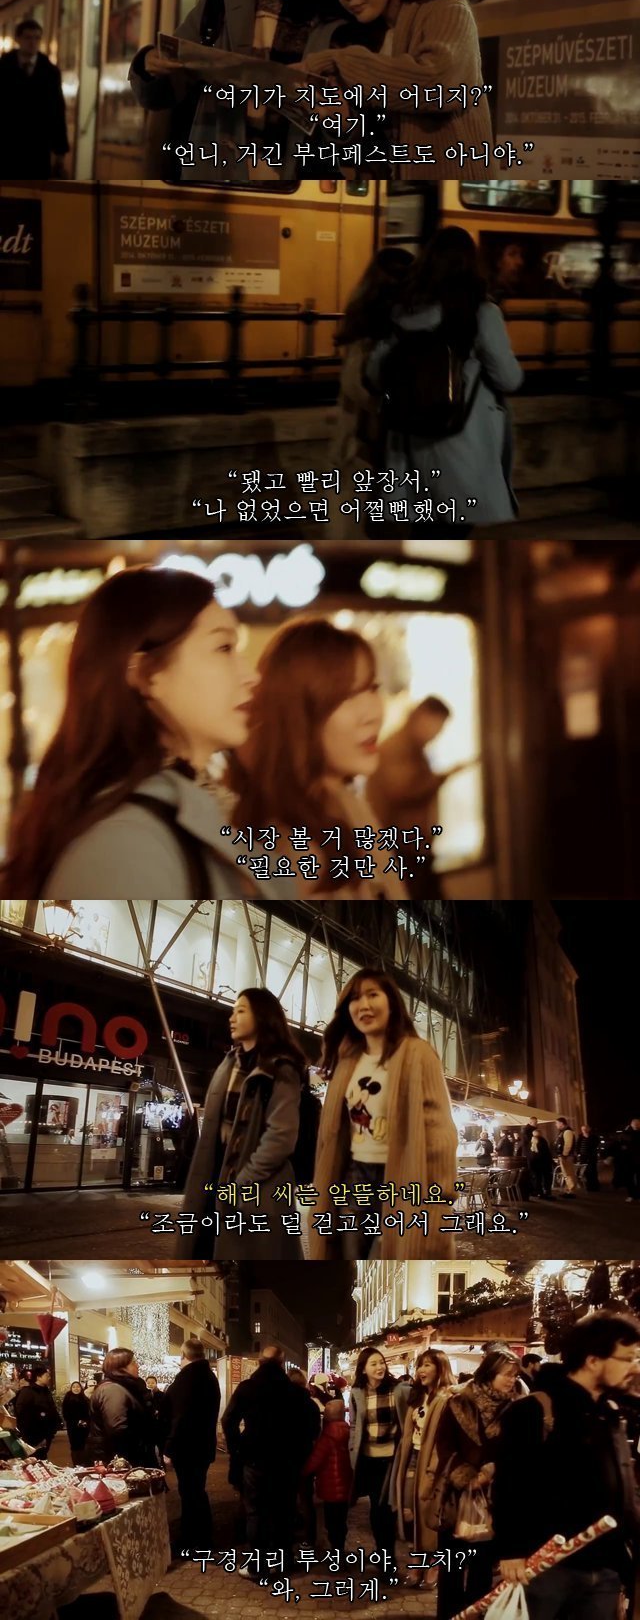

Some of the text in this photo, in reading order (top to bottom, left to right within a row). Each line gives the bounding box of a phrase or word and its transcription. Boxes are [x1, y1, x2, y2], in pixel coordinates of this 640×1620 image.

[506, 33, 633, 68] SZÉPMŰVÉSZETI
[505, 70, 568, 99] MÚZEUM
[120, 212, 230, 235] SZÉPMŰÉSZETI
[120, 232, 182, 250] MÚZEUM
[38, 1048, 145, 1078] BUDAPEST
